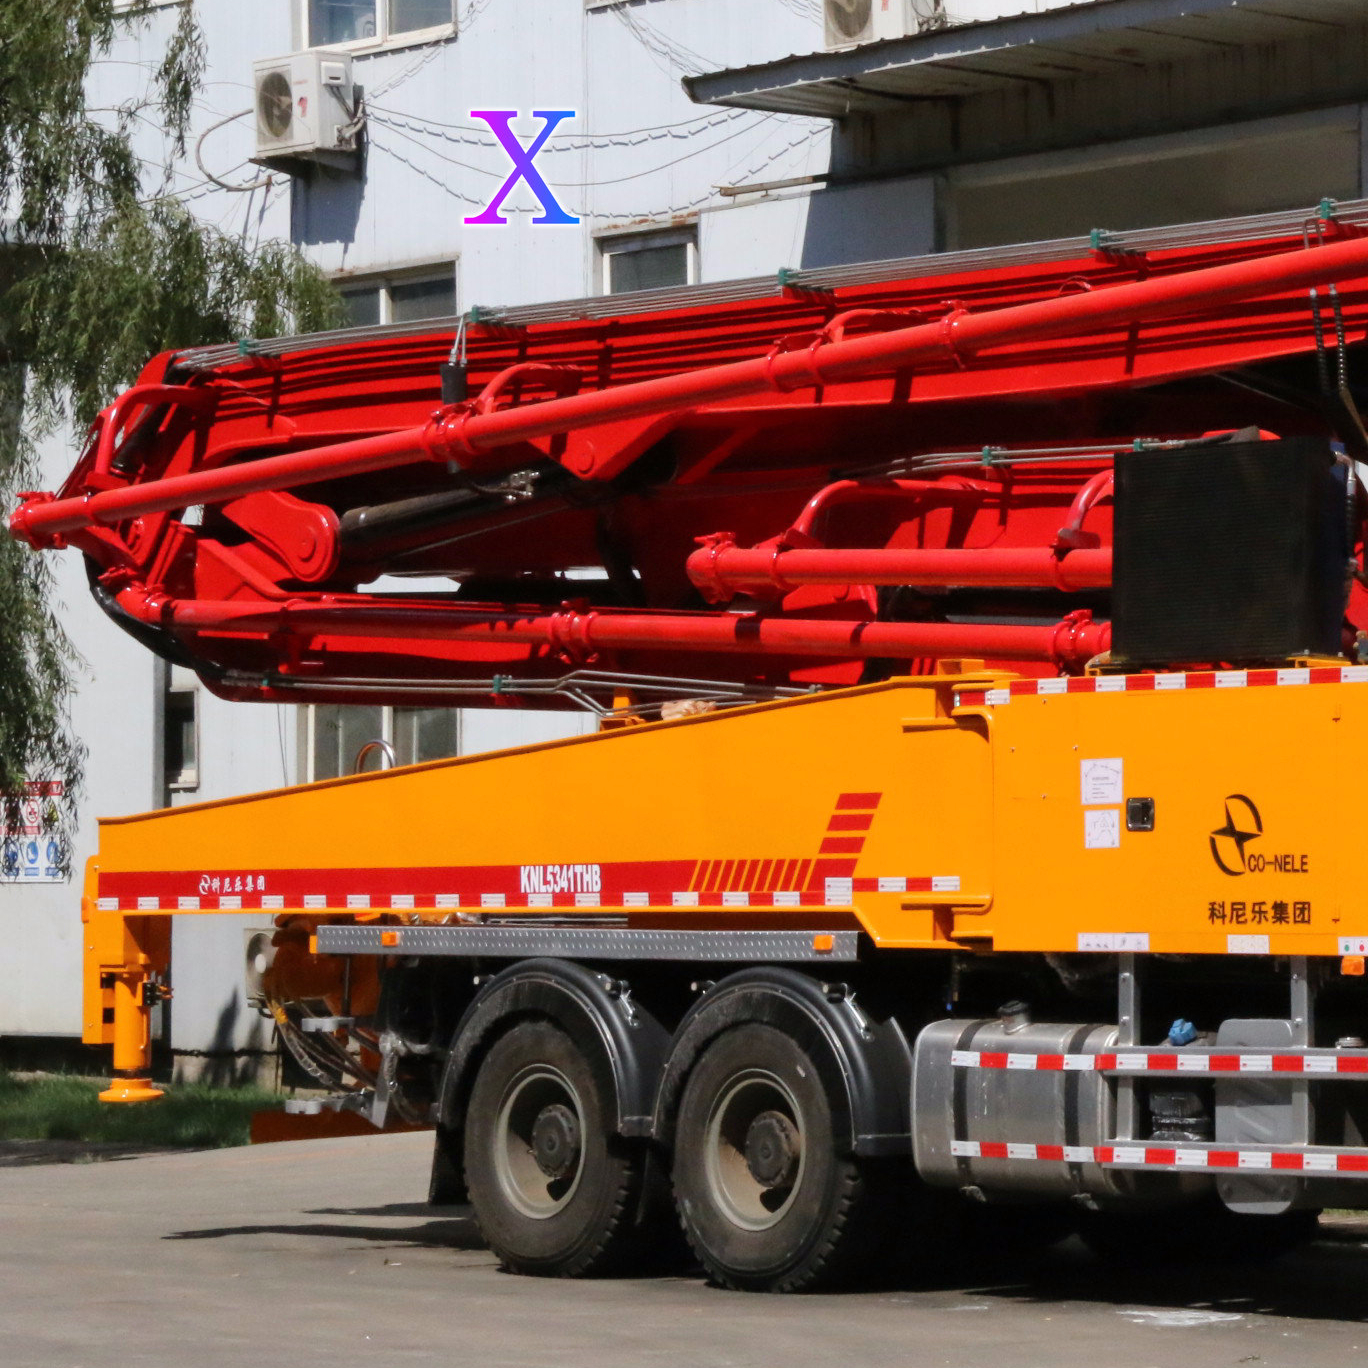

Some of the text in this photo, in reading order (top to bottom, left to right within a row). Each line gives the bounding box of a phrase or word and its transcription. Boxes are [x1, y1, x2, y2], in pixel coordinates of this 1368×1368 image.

[1247, 853, 1309, 873] CO-NELE
[211, 875, 266, 893] 科尼乐集团
[520, 864, 602, 893] KNL5341THB
[1208, 900, 1312, 925] 科尼乐集团
